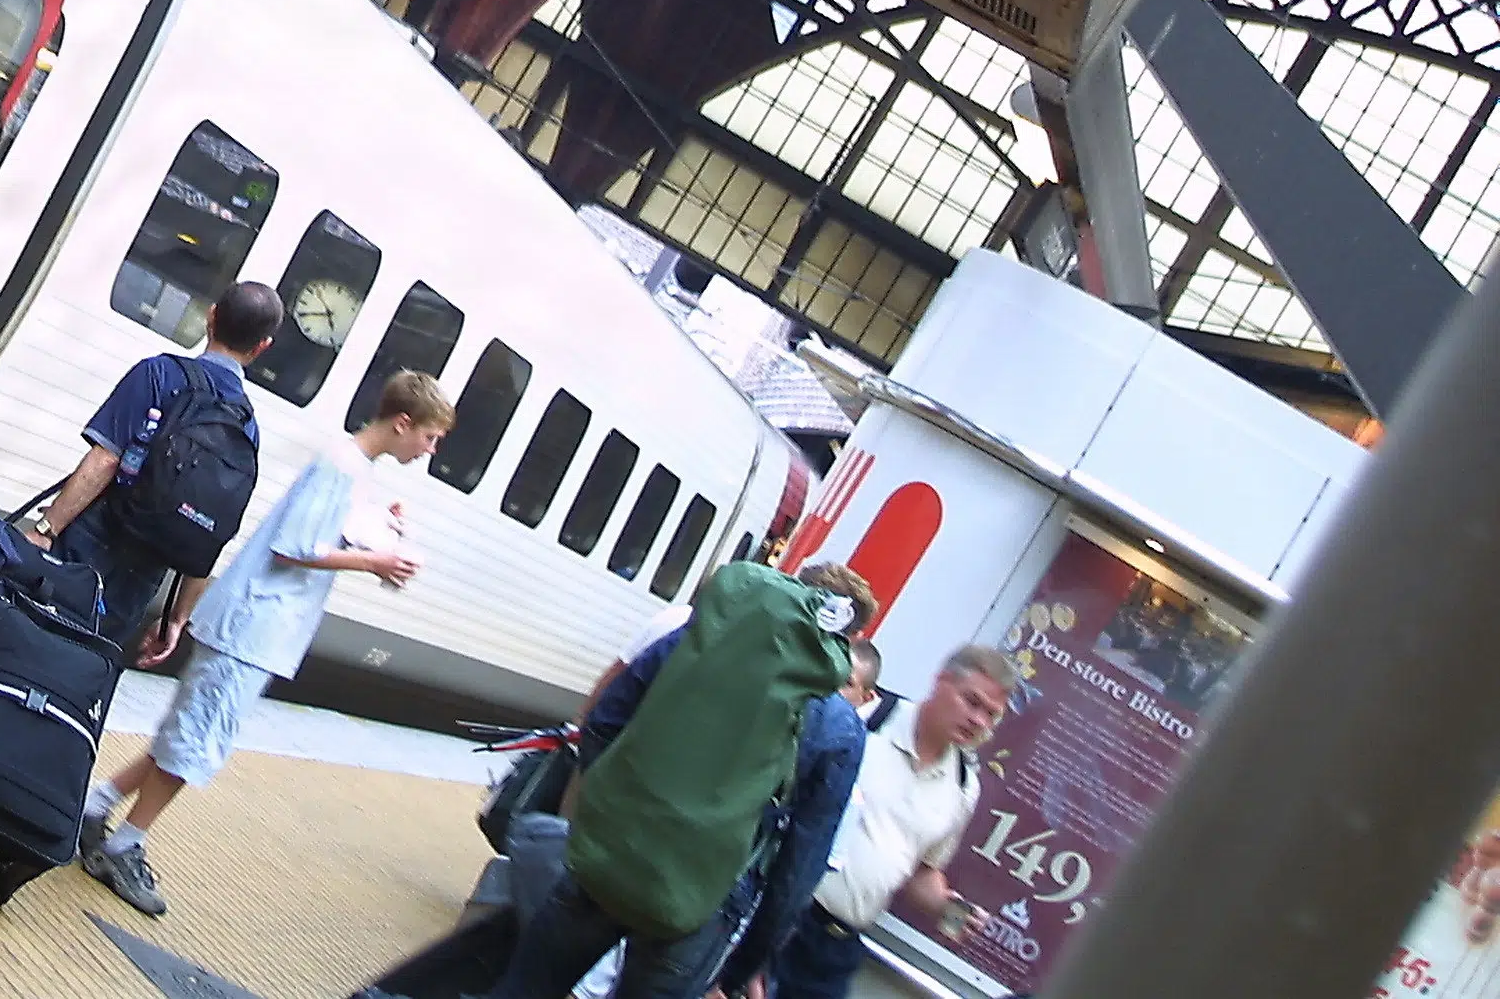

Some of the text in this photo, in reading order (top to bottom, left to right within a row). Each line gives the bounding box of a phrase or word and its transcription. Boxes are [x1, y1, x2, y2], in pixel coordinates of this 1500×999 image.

[1027, 629, 1071, 669] Den
[1070, 658, 1127, 700] store
[1127, 690, 1193, 740] Bistro
